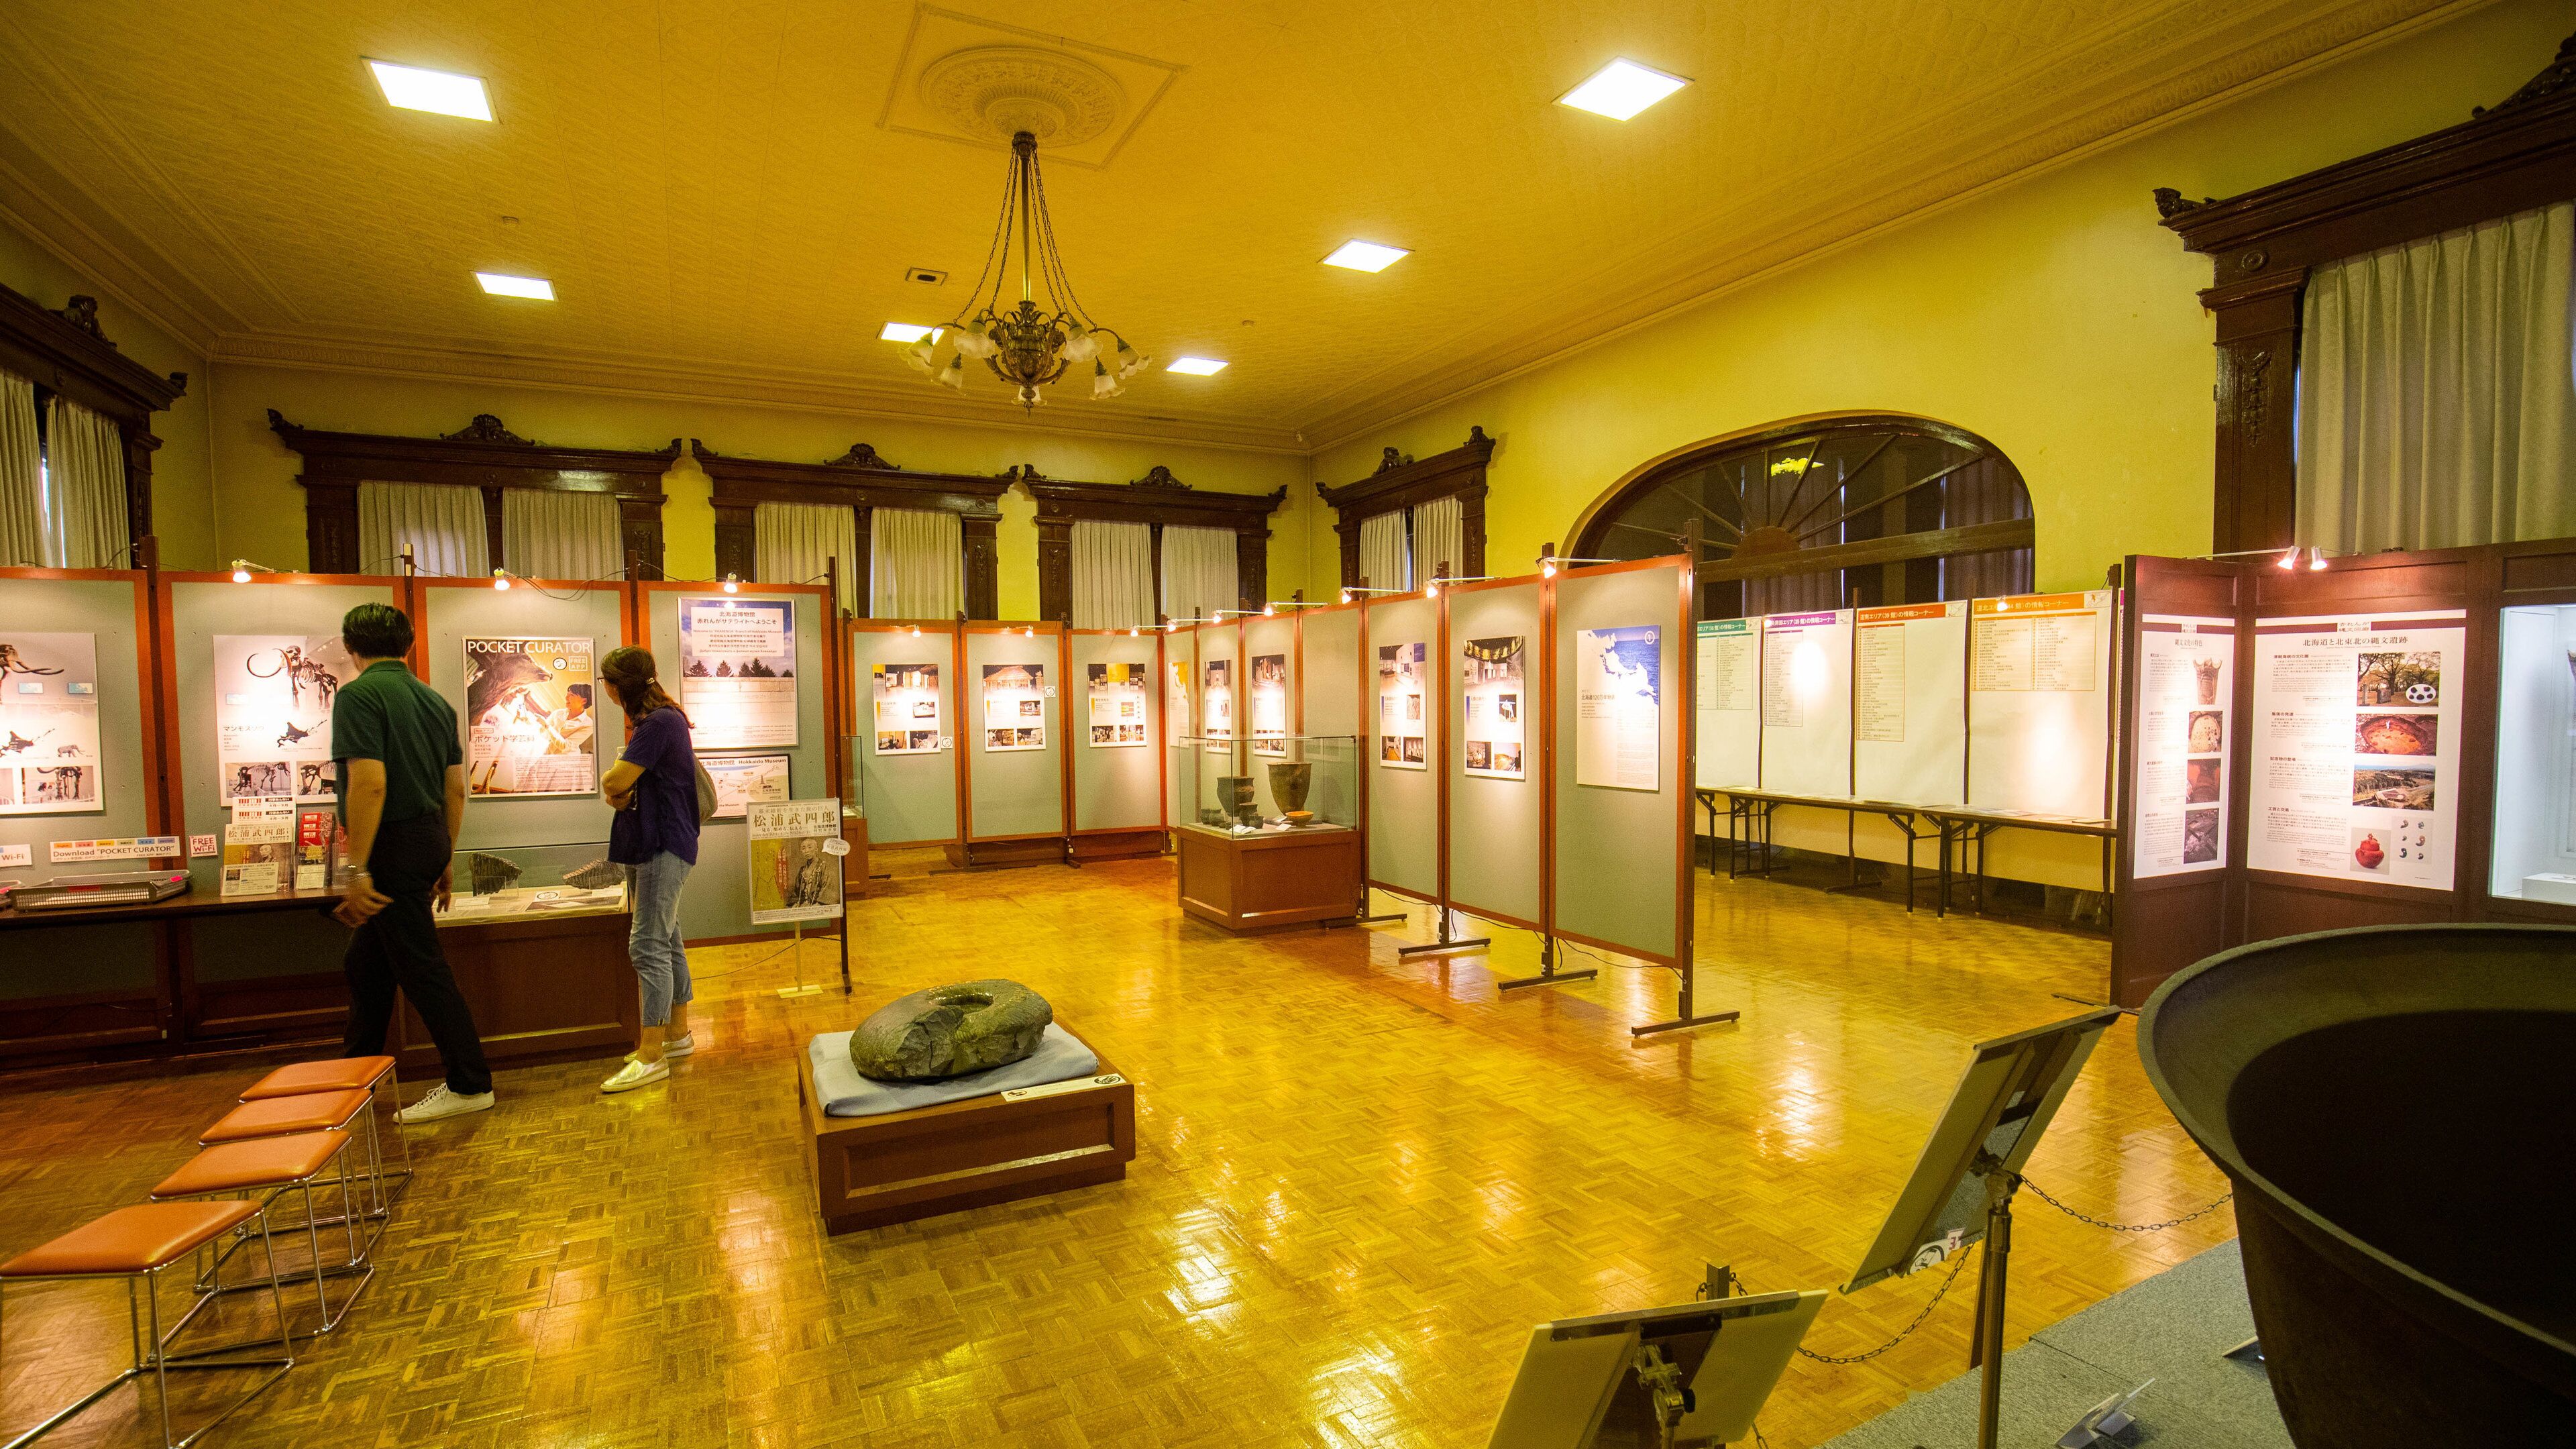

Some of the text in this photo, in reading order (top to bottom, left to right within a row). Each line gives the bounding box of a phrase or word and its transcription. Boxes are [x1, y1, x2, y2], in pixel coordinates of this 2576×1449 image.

[468, 641, 590, 653] POCKET CURATOR
[2303, 636, 2408, 647] 北海道と北東北の縄文遺跡
[753, 811, 835, 827] 松浦武四郎
[228, 828, 285, 839] 松浦武四郎
[53, 849, 95, 857] Download
[193, 844, 215, 852] Wi-Fi
